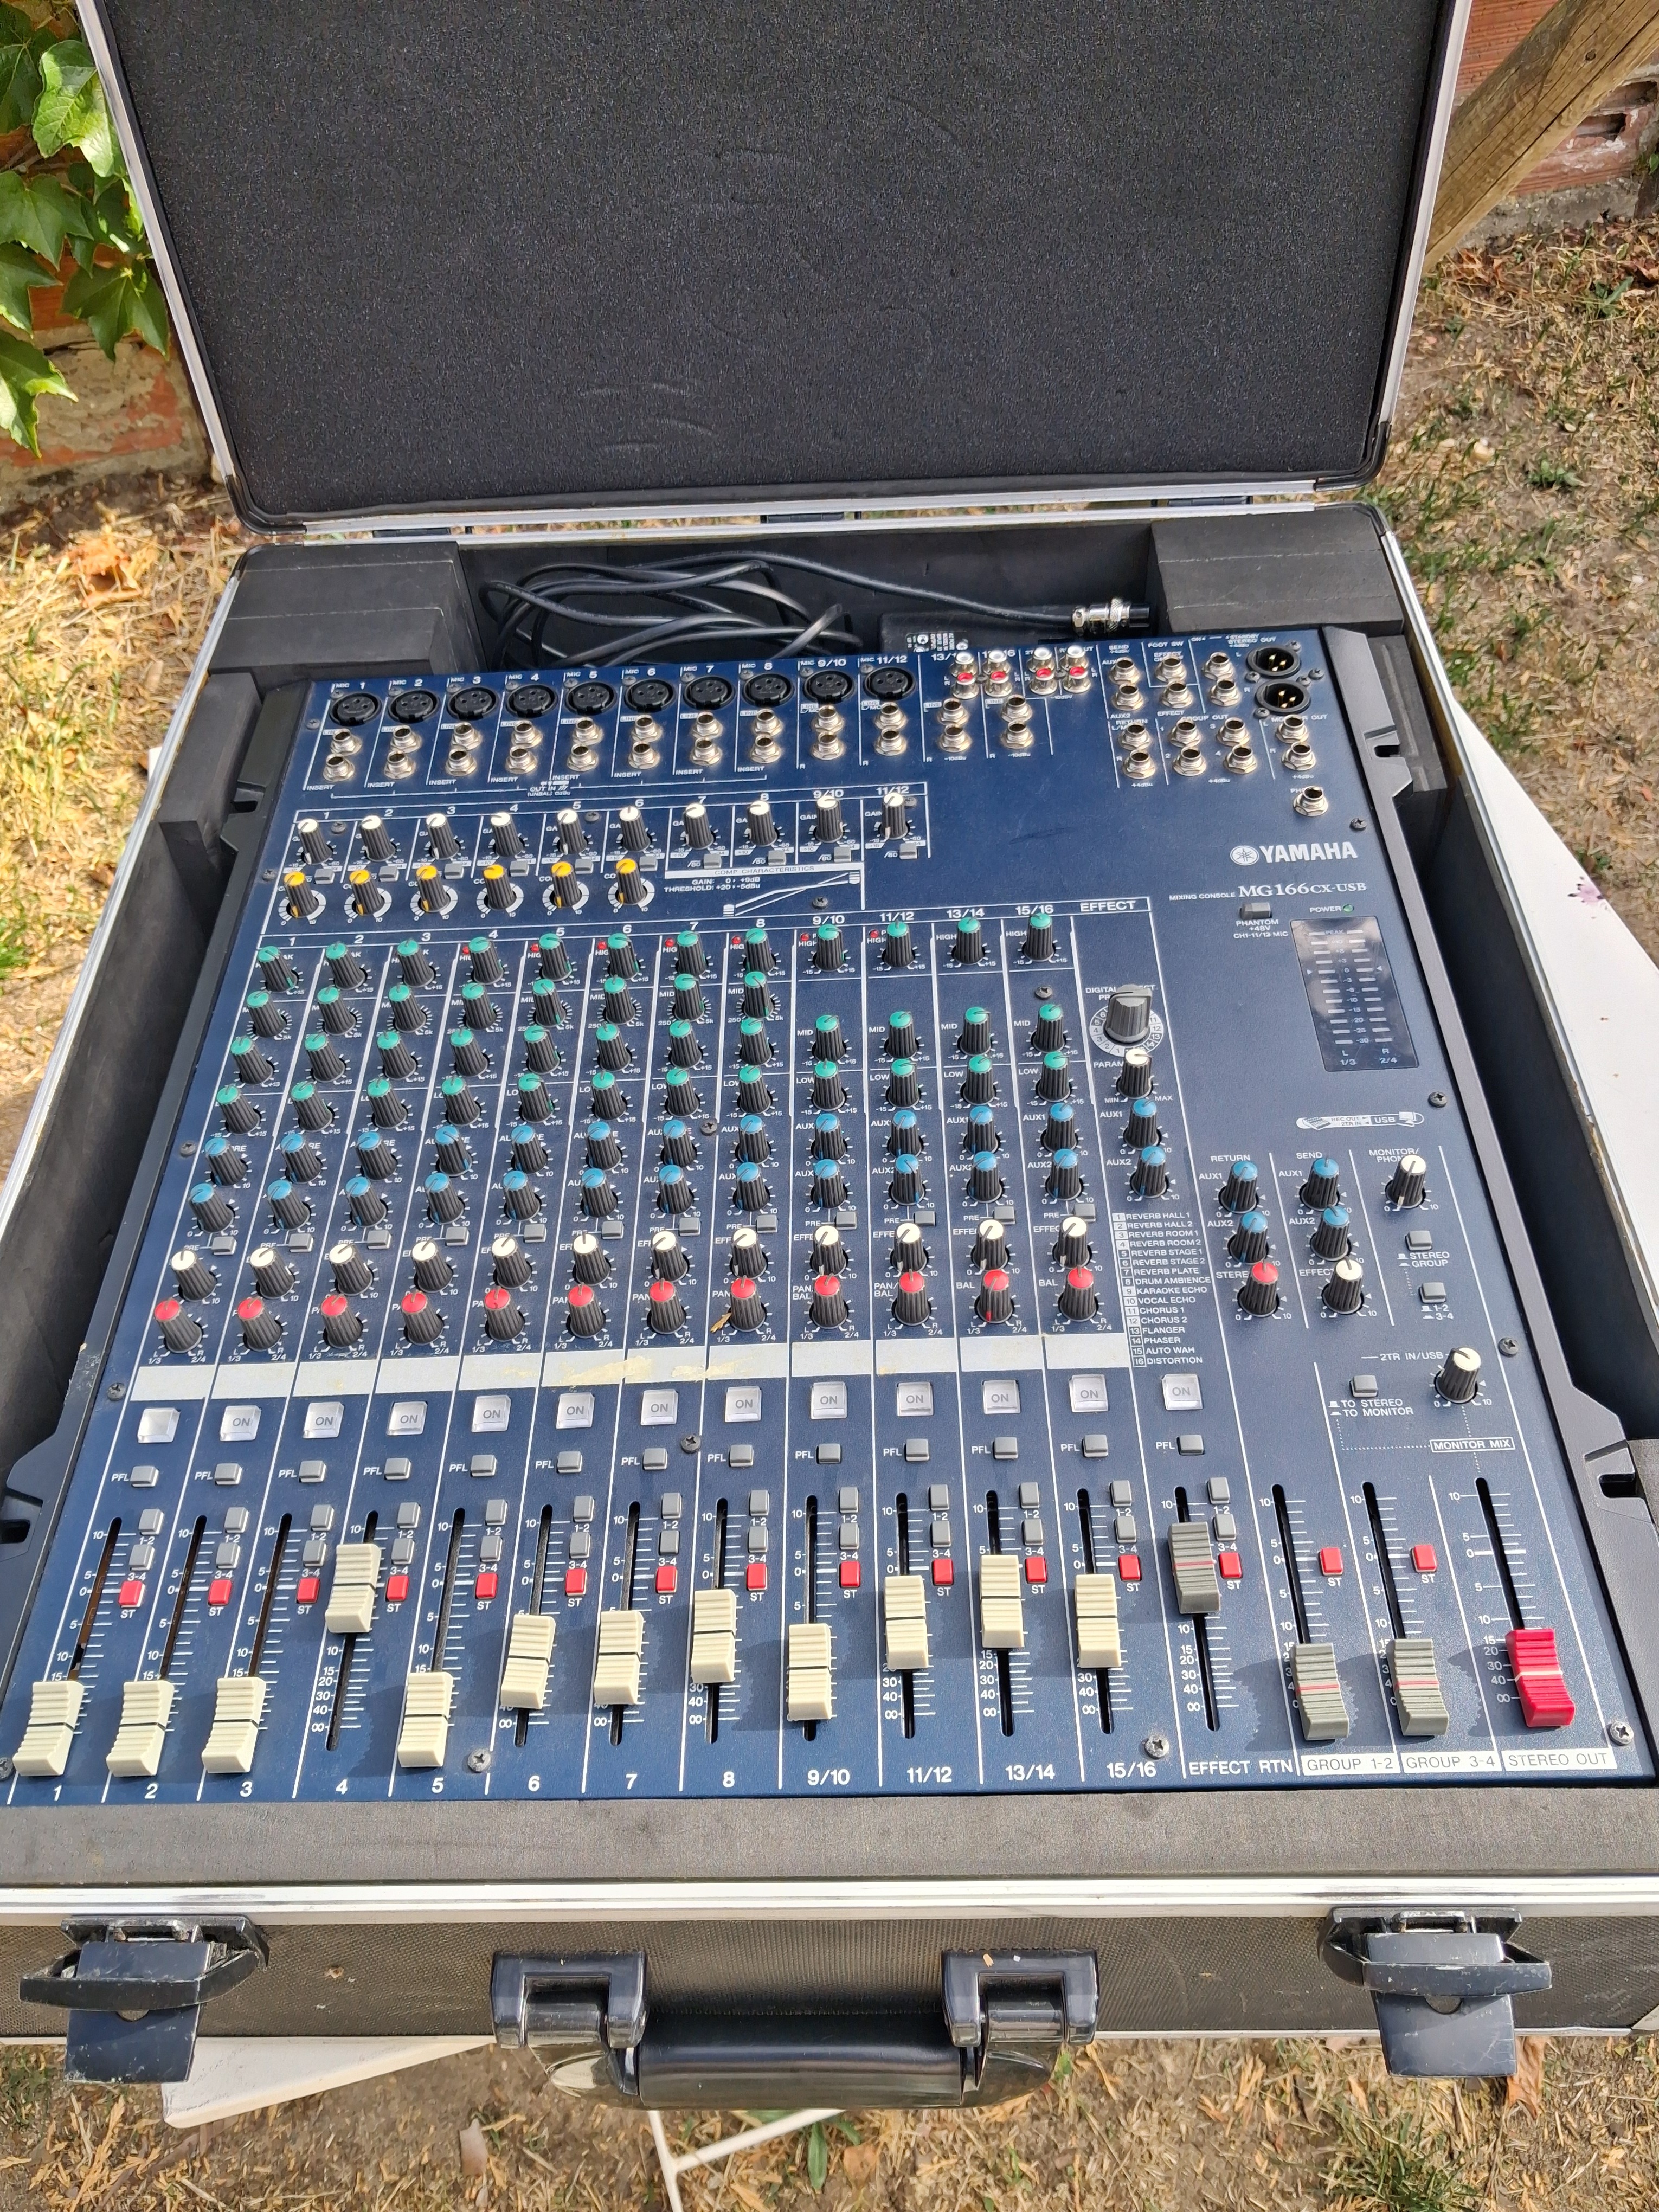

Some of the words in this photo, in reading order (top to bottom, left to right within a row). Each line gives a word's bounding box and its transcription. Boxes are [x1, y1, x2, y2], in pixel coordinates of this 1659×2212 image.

[1259, 842, 1357, 863] YAMAHA
[742, 866, 814, 874] CHARACTERISTICS
[1238, 883, 1366, 897] MG166CX-USB
[1016, 905, 1053, 915] 15/16
[1080, 901, 1136, 911] EFFECT
[880, 912, 915, 922] 11/12
[947, 908, 984, 918] 13/14
[756, 919, 765, 928] 8
[813, 915, 845, 924] 9/10
[623, 924, 632, 934] 6
[690, 922, 698, 930] 7
[488, 930, 498, 939] 4
[556, 927, 565, 936] 5
[290, 937, 295, 946] 1
[355, 935, 364, 944] 2
[422, 933, 430, 941] 3
[1374, 1116, 1395, 1124] USB
[1369, 1148, 1419, 1156] MONITOR/
[1412, 1259, 1448, 1268] GROUP
[1406, 1352, 1443, 1360] IN/USB
[1172, 1387, 1190, 1396] ON
[906, 1395, 923, 1404] ON
[1361, 1399, 1403, 1407] STEREO
[651, 1403, 668, 1412] ON
[1363, 1408, 1413, 1416] MONITOR
[233, 1418, 250, 1426] ON
[1433, 1441, 1485, 1450] MONITOR
[1489, 1439, 1510, 1448] MIX
[1422, 1575, 1435, 1583] ST
[937, 1587, 951, 1596] ST
[750, 1592, 763, 1601] ST
[387, 1604, 401, 1612] ST
[1484, 1647, 1498, 1656] 20
[1488, 1661, 1502, 1670] 30
[1491, 1676, 1506, 1684] 40
[1406, 1756, 1461, 1769] GROUP
[1470, 1755, 1495, 1767] 3-4
[1509, 1754, 1569, 1766] STEREO
[1576, 1753, 1607, 1764] OUT
[1189, 1761, 1250, 1774] EFFECT
[1259, 1760, 1292, 1773] RTN
[1307, 1759, 1361, 1771] GROUP
[1372, 1758, 1393, 1769] 1-2
[907, 1767, 952, 1783] 11/12
[1006, 1765, 1055, 1780] 13/14
[1107, 1763, 1156, 1778] 15/16
[626, 1774, 637, 1789] 7
[723, 1771, 735, 1787] 8
[808, 1770, 850, 1785] 9/10
[336, 1779, 347, 1794] 4
[432, 1778, 443, 1793] 5
[529, 1776, 540, 1791] 6
[53, 1785, 61, 1801] 1
[145, 1784, 158, 1798] 2
[240, 1782, 253, 1797] 3
